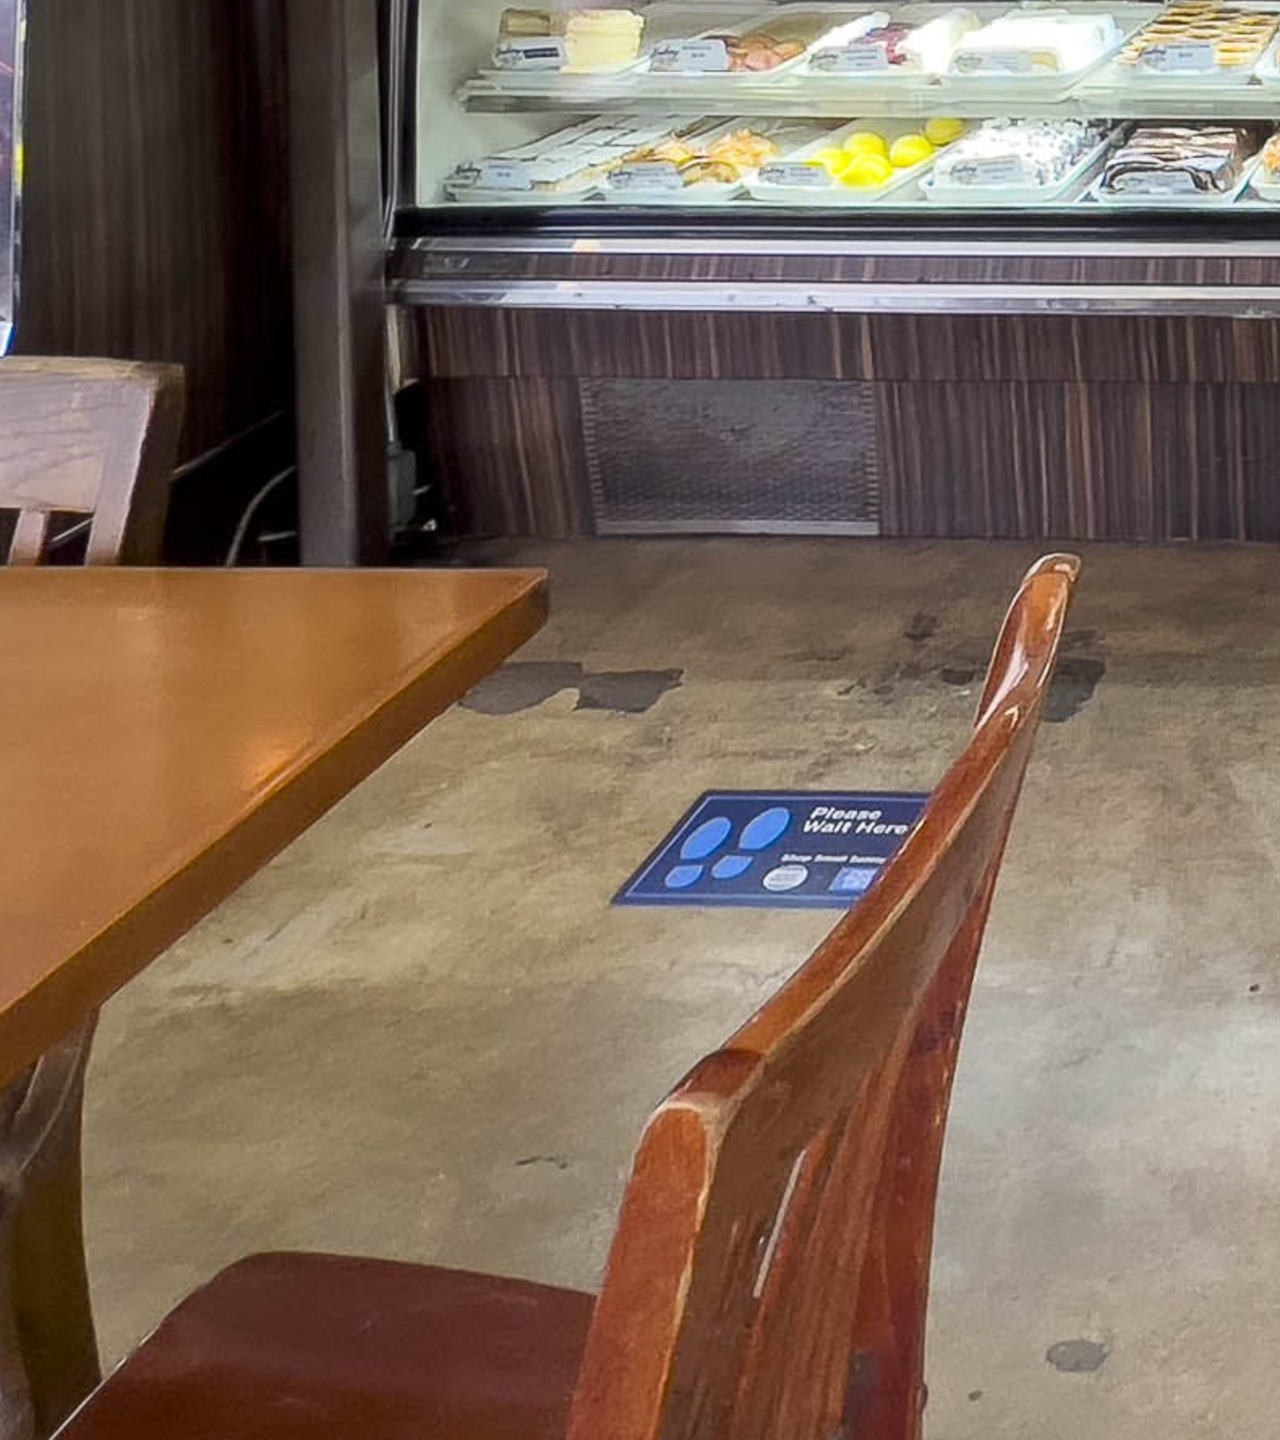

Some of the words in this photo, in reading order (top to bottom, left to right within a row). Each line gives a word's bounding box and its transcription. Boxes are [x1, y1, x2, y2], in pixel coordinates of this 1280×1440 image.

[810, 807, 882, 820] Please
[803, 820, 852, 833] Wait
[856, 822, 909, 835] Here
